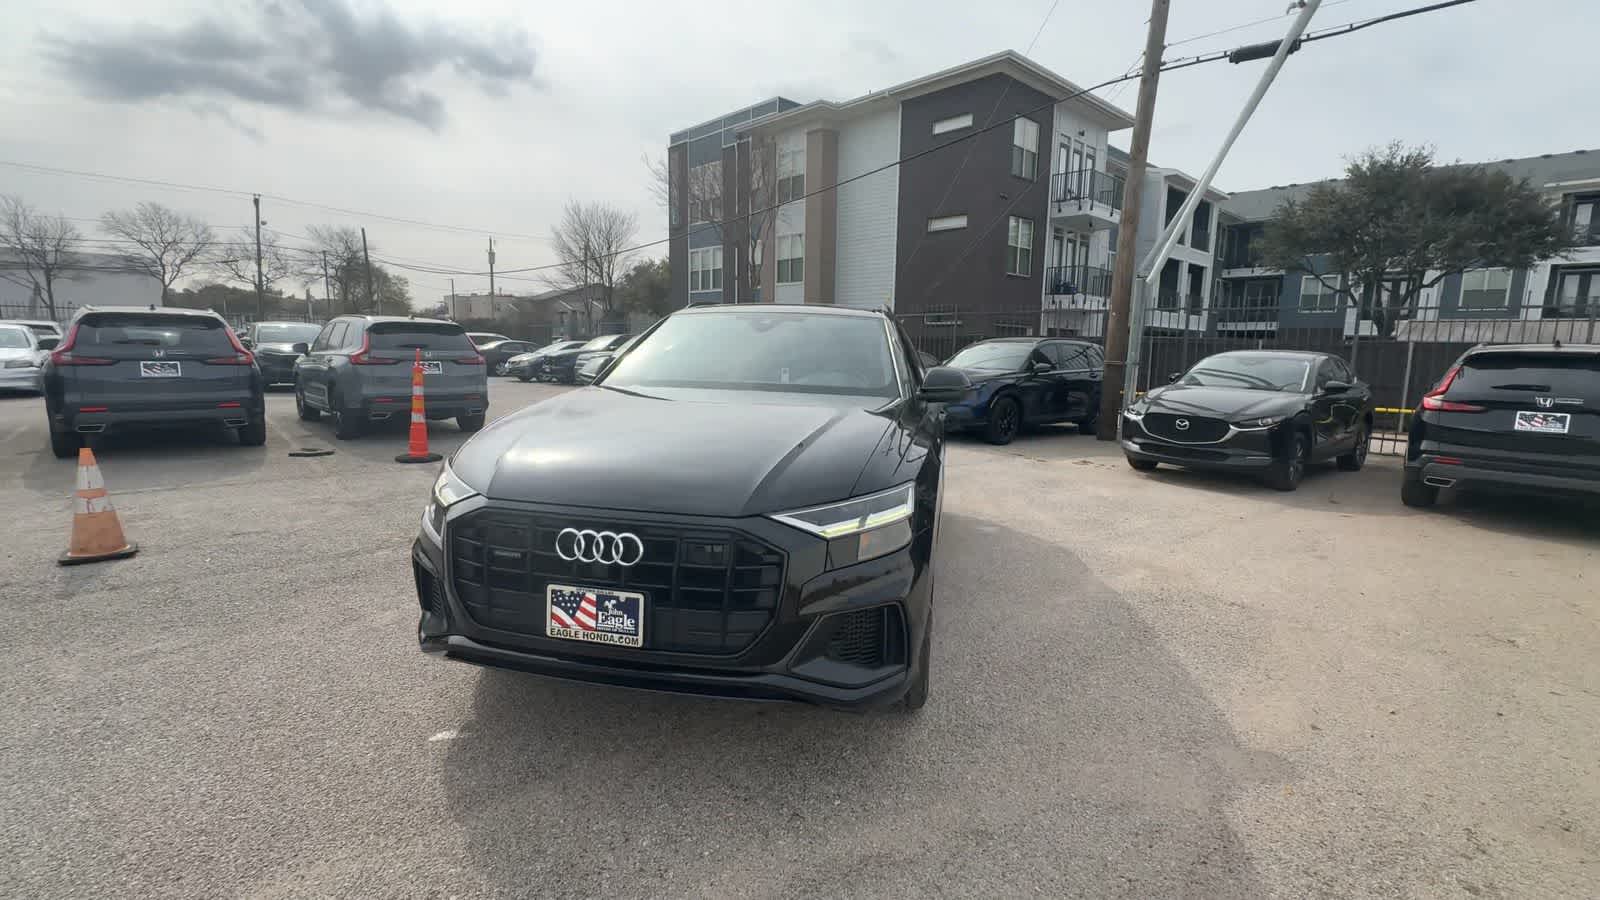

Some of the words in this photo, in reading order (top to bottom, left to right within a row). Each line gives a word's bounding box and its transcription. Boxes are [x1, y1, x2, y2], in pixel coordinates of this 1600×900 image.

[598, 611, 635, 629] Eagle
[608, 608, 623, 616] John
[550, 628, 580, 639] EAGLE
[583, 632, 639, 646] HONDA.COM
